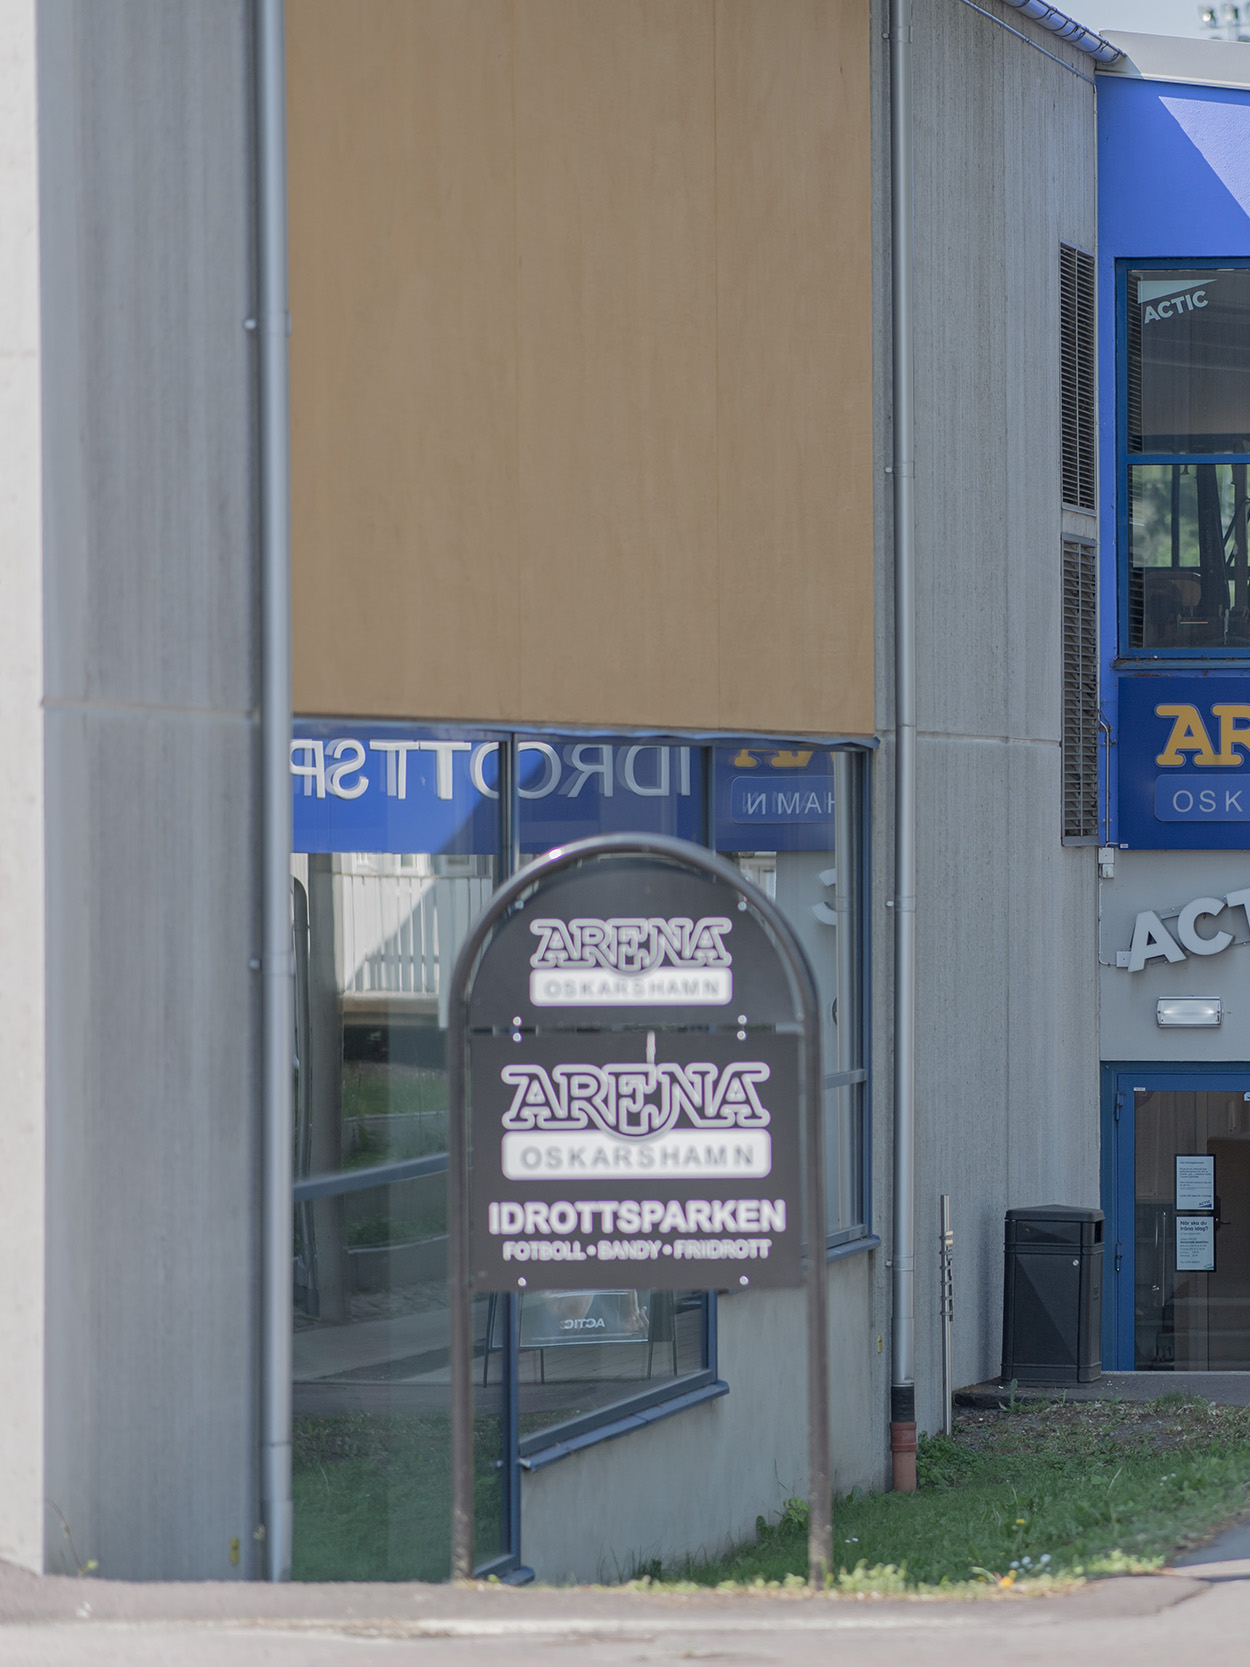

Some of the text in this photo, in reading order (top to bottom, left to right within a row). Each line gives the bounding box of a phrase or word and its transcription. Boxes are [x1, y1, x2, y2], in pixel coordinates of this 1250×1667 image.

[1144, 290, 1209, 324] ACTIC
[529, 917, 732, 976] ARENA
[543, 979, 720, 998] OSKARSHAMN
[501, 1062, 771, 1142] ARENA
[520, 1144, 755, 1170] OSKARSHAMN
[488, 1199, 787, 1235] IDROTTSPARKEN
[502, 1240, 588, 1261] FOTBOLL
[597, 1239, 663, 1261] BANDY
